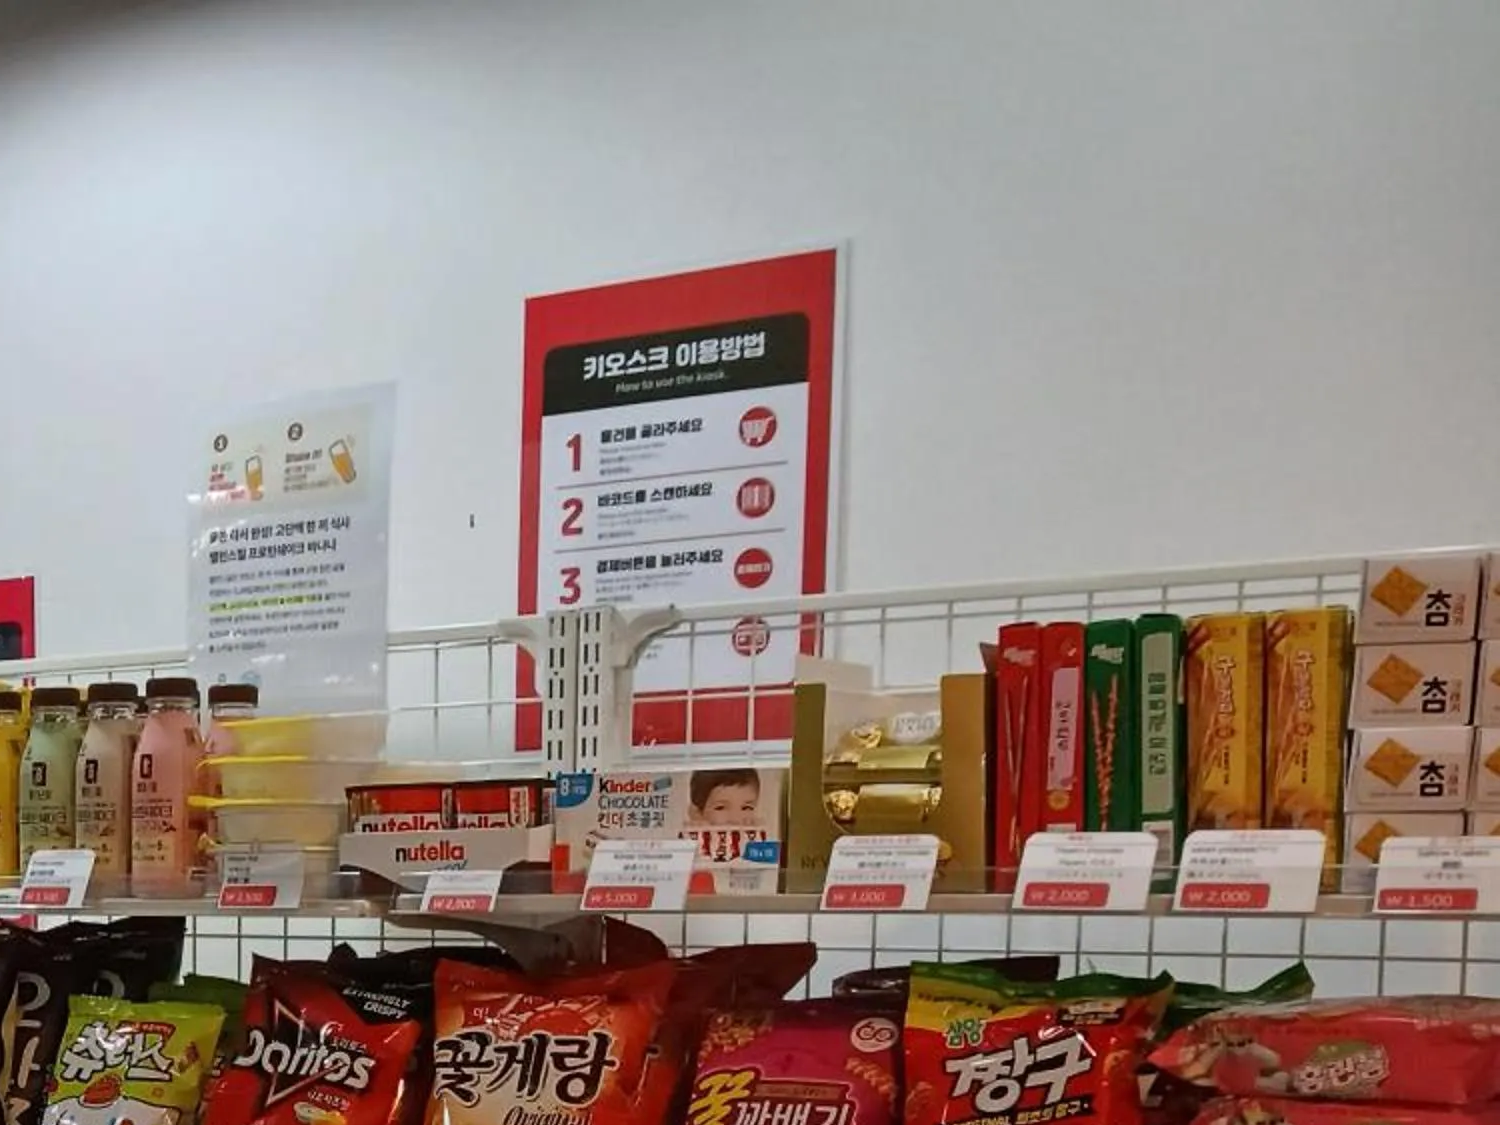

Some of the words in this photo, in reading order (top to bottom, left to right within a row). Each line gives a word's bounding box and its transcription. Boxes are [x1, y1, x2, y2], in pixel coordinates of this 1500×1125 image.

[583, 345, 668, 380] 키오스크
[676, 331, 766, 367] 이용방법
[642, 418, 703, 439] 골라주세요
[566, 433, 582, 472] 1
[598, 488, 648, 507] 바코드를
[561, 498, 583, 536] 2
[560, 567, 581, 604] 3
[600, 777, 651, 793] Kinder
[598, 794, 669, 809] CHOCOLATE
[597, 812, 623, 828] 킨더
[625, 811, 665, 828] 초콜릿
[395, 840, 465, 862] nutella
[1208, 890, 1251, 902] 2,000
[363, 1001, 407, 1020] CRISPY
[233, 1029, 376, 1090] Doritos
[945, 1035, 1093, 1114] 짱구
